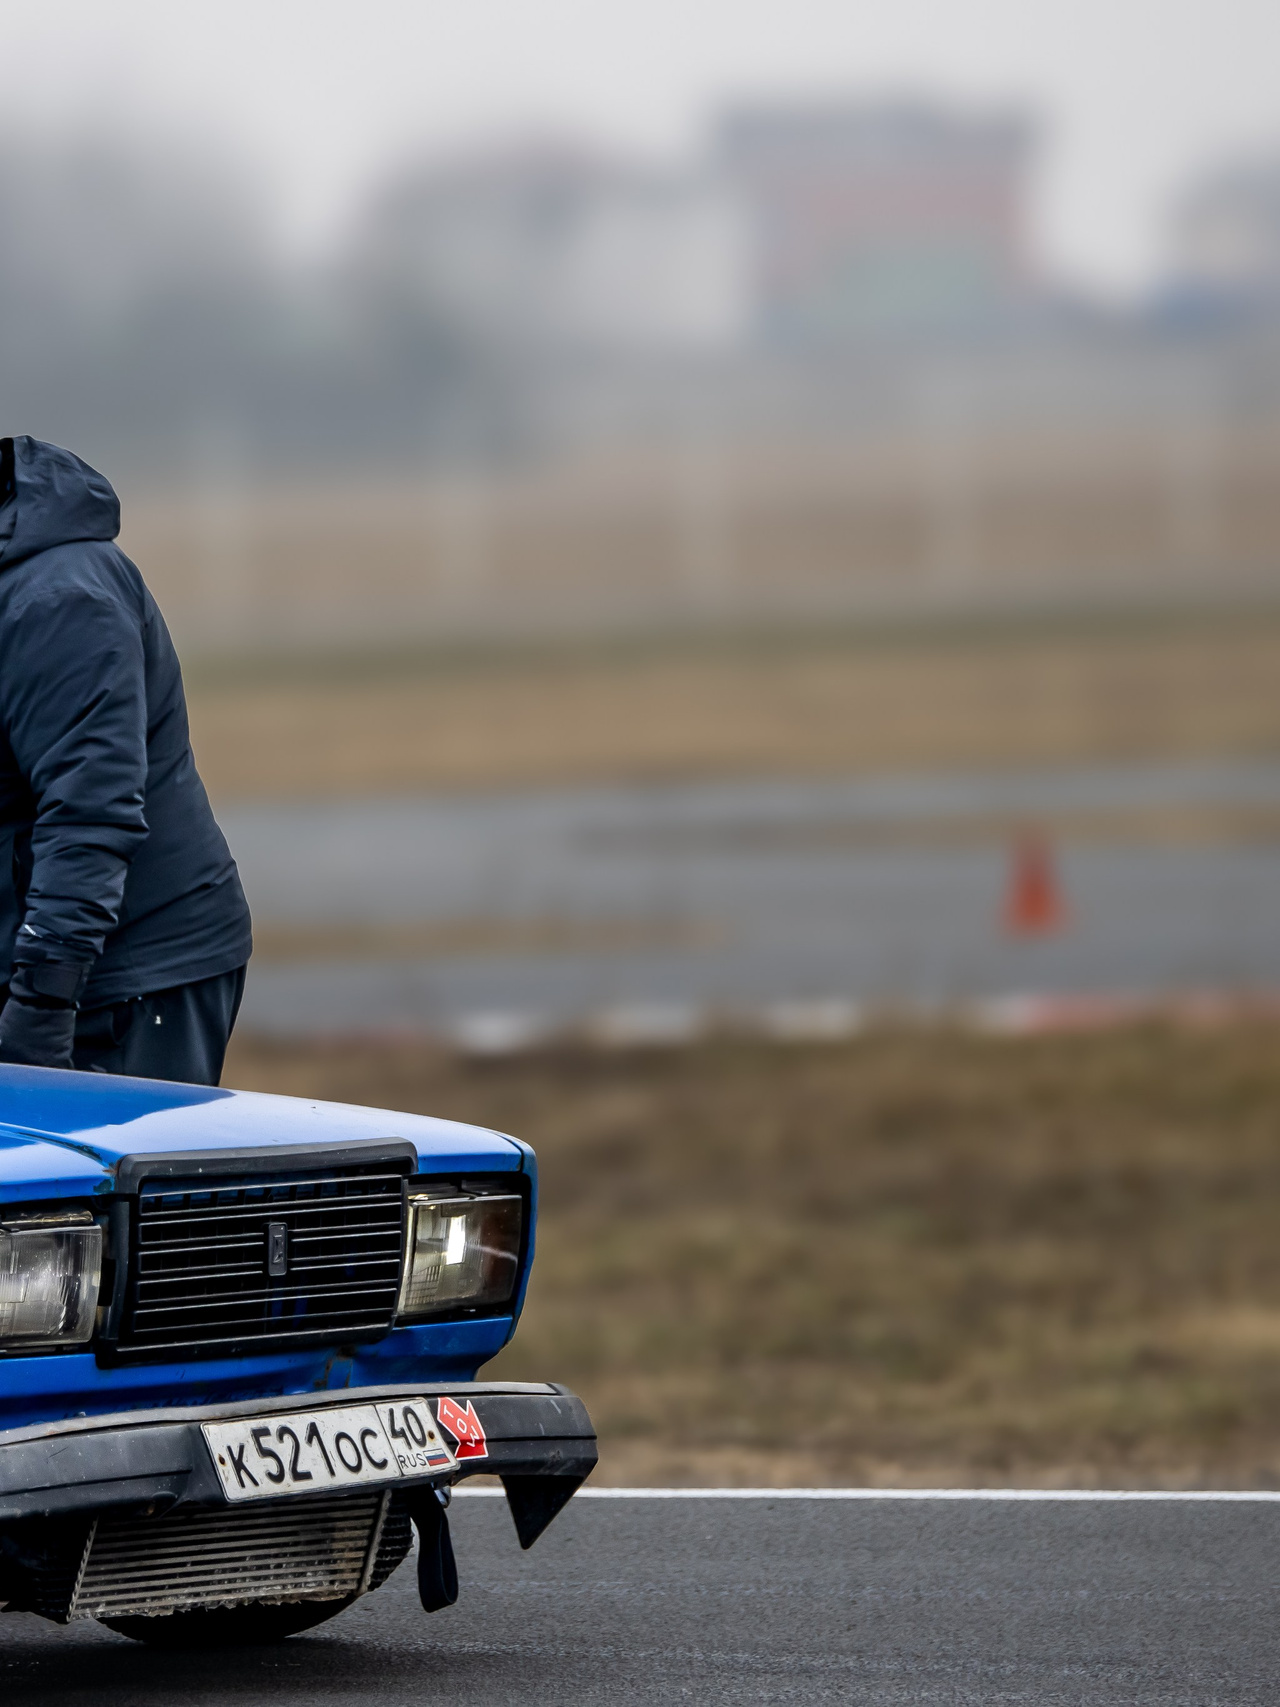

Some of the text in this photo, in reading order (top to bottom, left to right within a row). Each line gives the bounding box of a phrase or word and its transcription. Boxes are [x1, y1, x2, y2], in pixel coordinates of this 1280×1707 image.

[389, 1406, 427, 1450] 40
[443, 1404, 480, 1447] TOW
[398, 1454, 427, 1470] RUS
